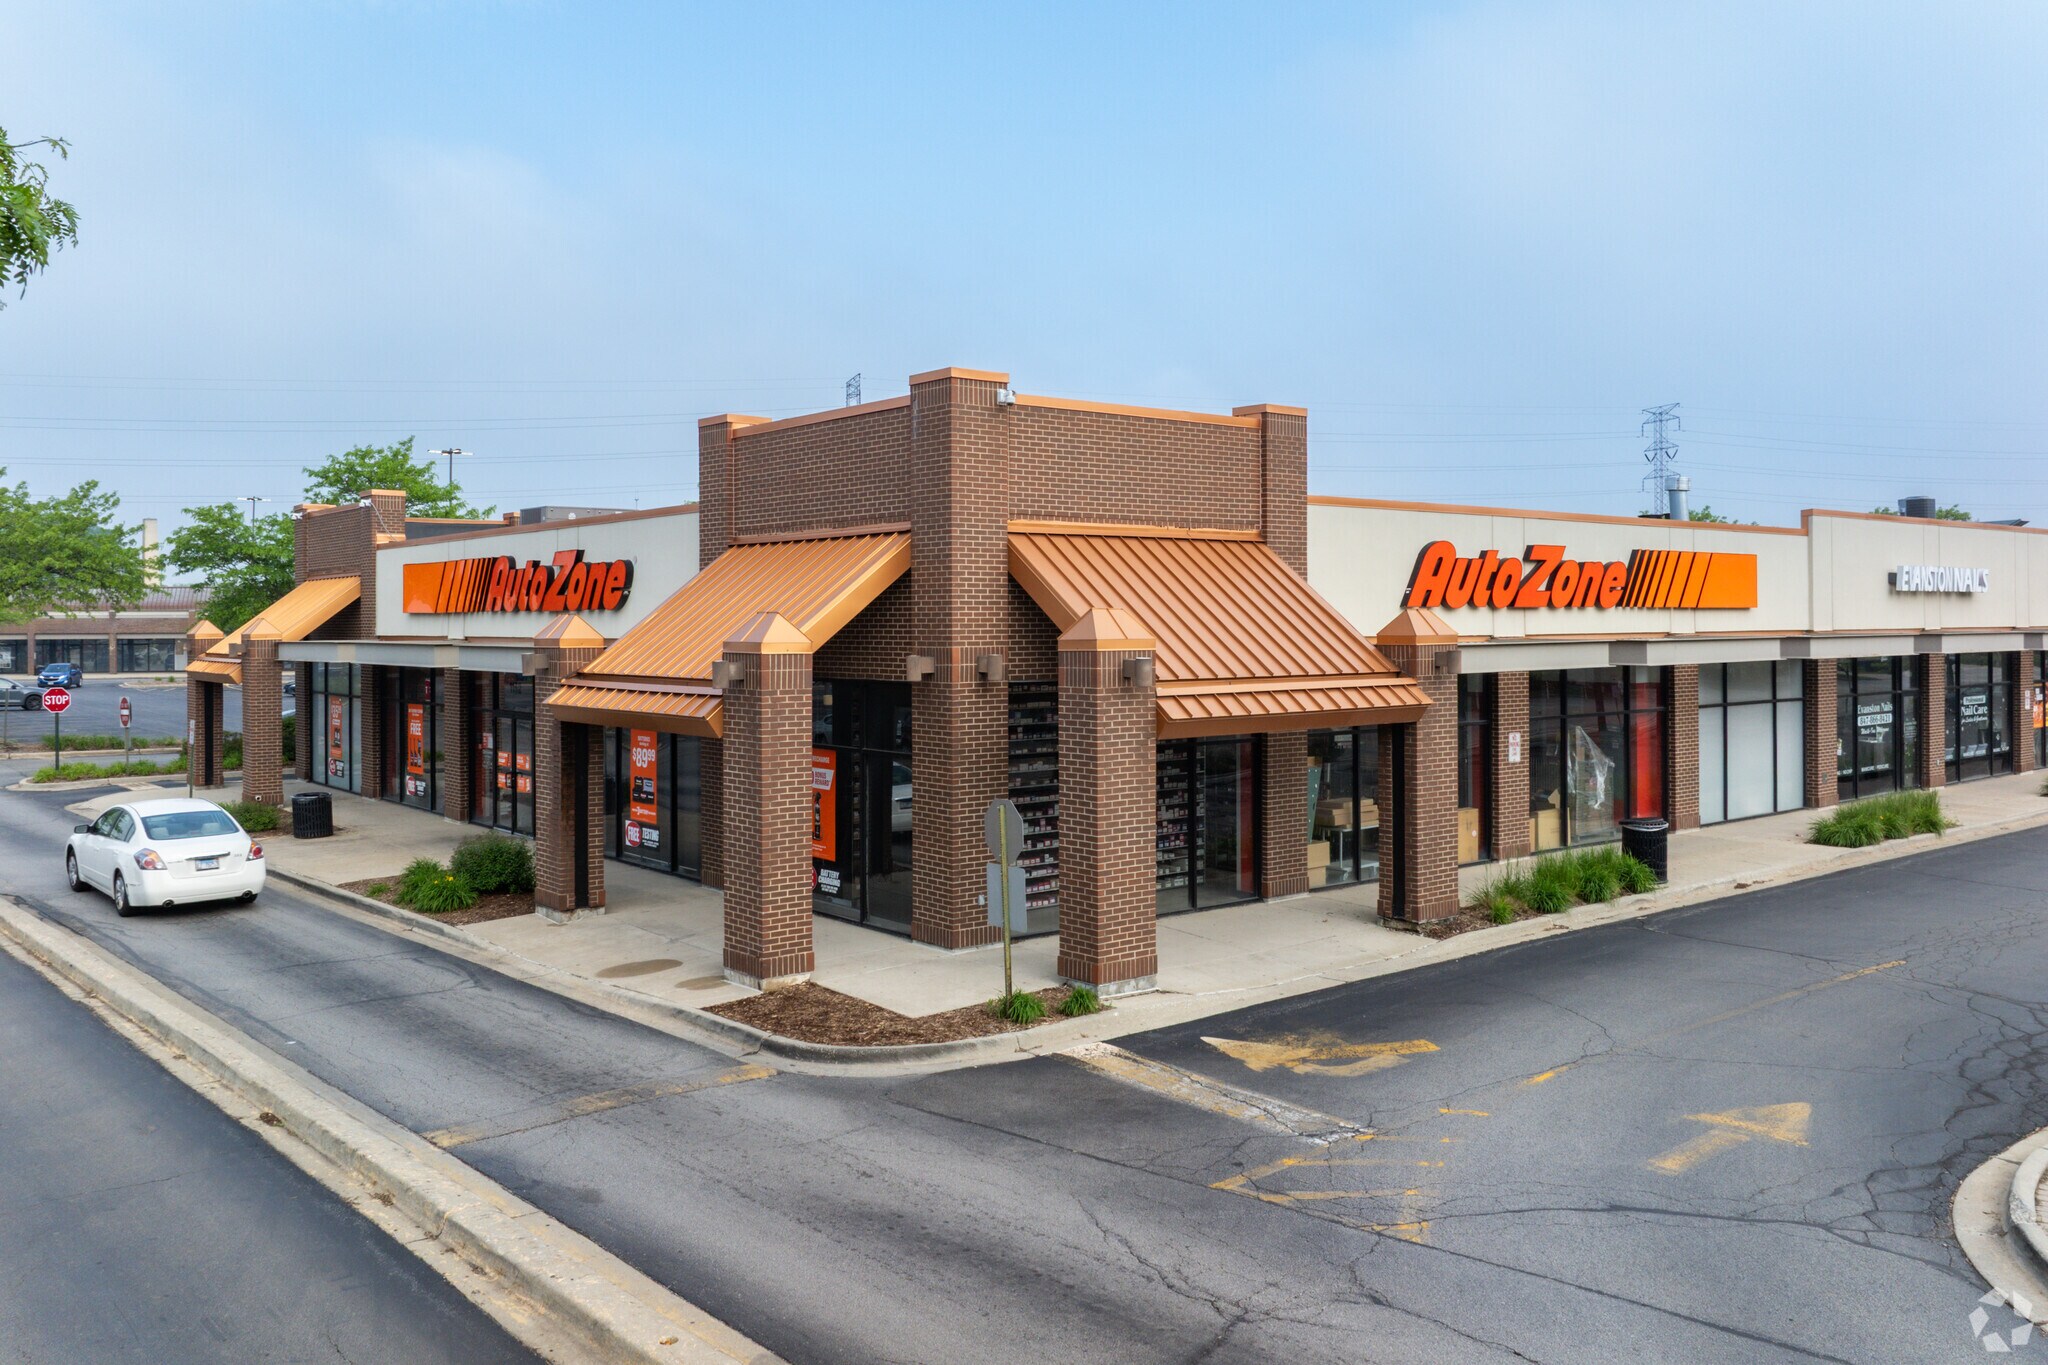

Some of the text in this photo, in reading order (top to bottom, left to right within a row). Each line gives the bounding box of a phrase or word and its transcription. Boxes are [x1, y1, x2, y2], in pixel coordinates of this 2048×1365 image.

[487, 549, 633, 612] AutoZone
[1403, 540, 1627, 609] AutoZone
[1900, 565, 1990, 593] EVANSTON NAILS
[44, 695, 69, 705] STOP
[1858, 701, 1893, 714] Evanston Nails
[1961, 705, 1988, 716] Nail Care
[410, 723, 422, 735] FREE
[627, 826, 640, 842] FREE
[642, 827, 660, 842] TESTING
[821, 868, 840, 879] BATTERY
[818, 876, 841, 887] CHARGING
